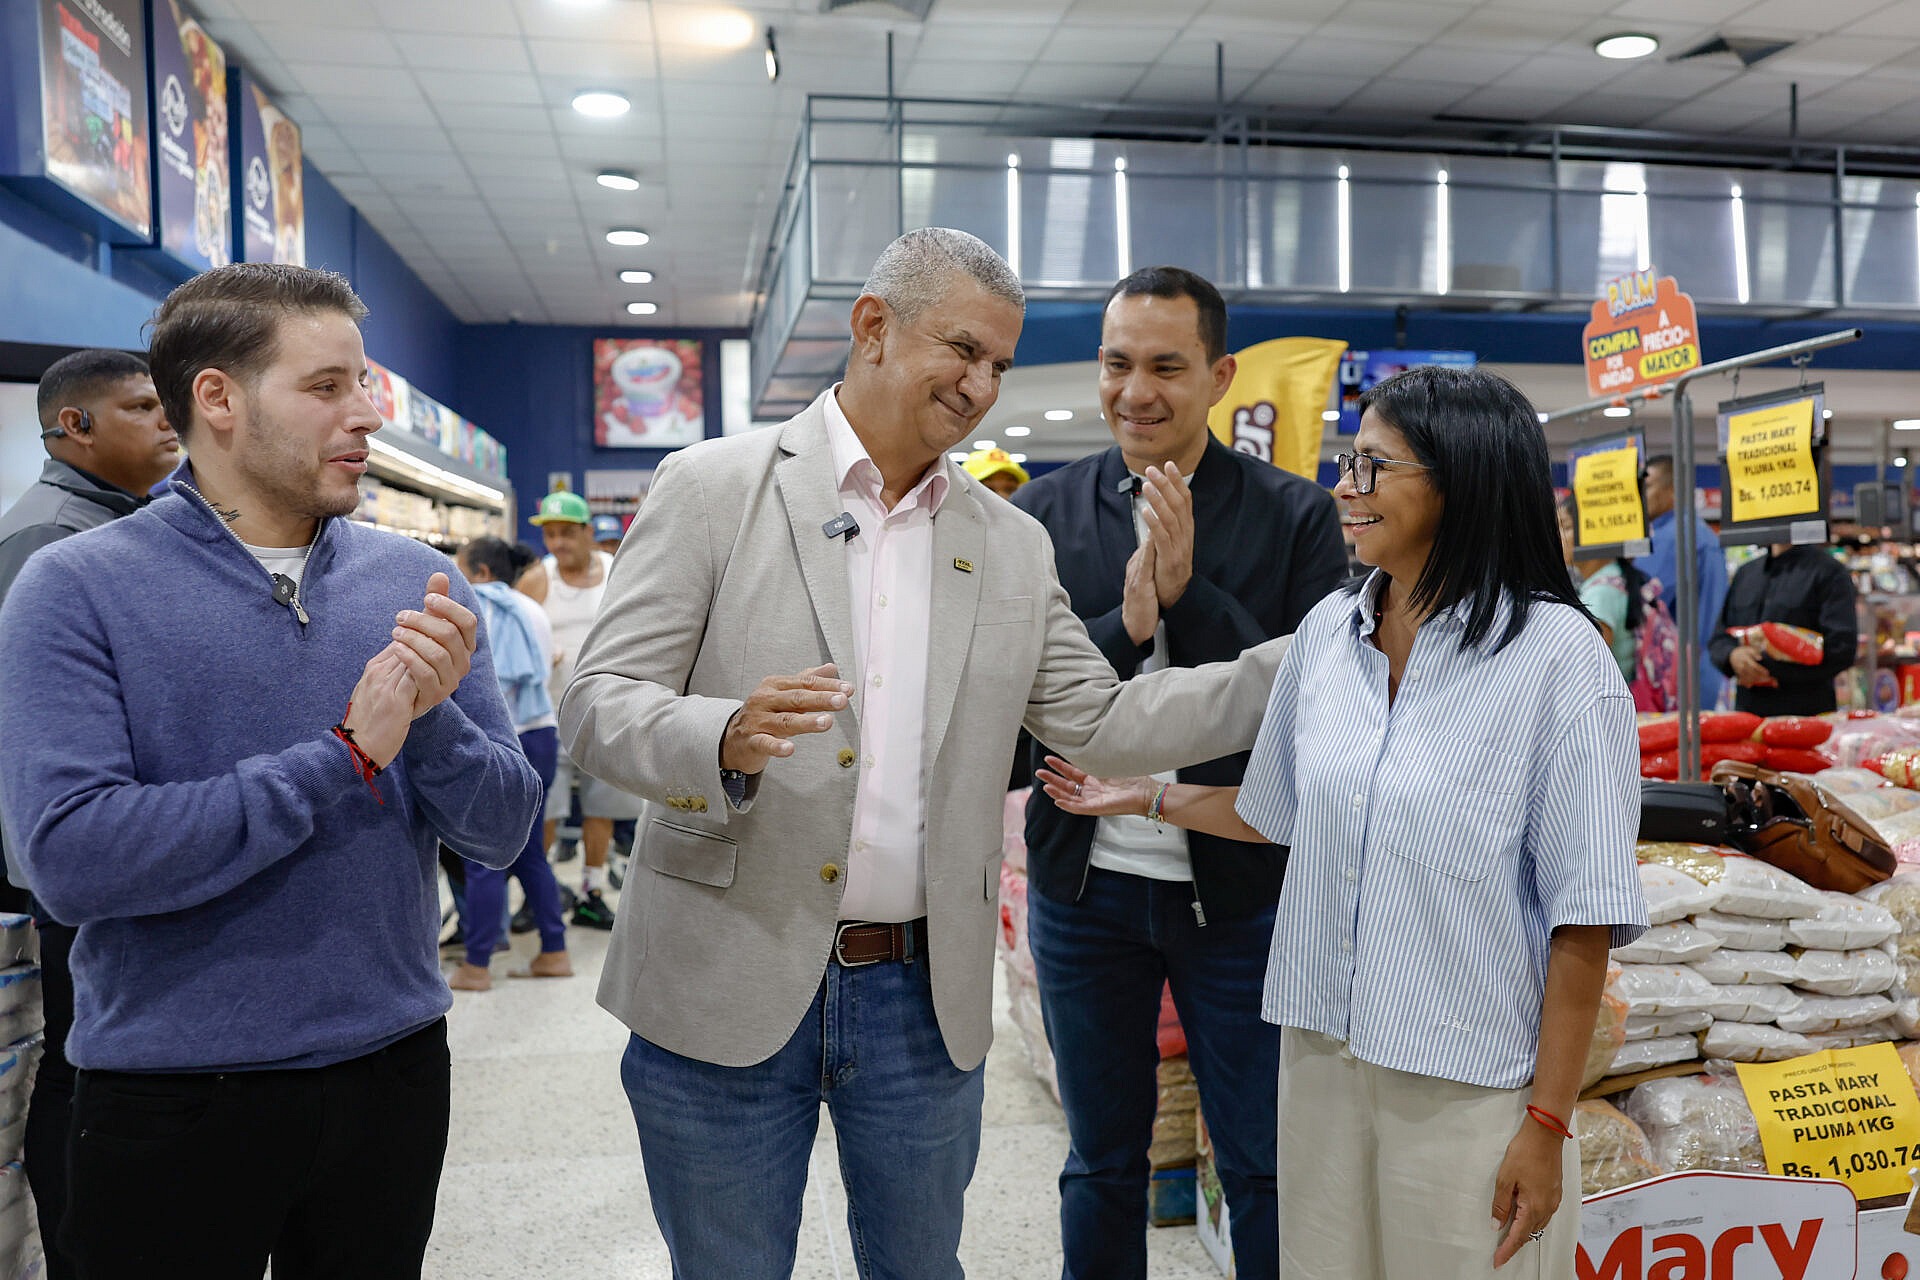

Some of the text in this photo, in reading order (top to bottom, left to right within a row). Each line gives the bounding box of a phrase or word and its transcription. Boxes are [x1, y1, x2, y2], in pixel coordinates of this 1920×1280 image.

[1658, 309, 1671, 328] A
[1589, 329, 1639, 360] COMPRA
[1642, 325, 1683, 353] PRECIO
[1646, 347, 1692, 373] MAYOR
[1740, 426, 1797, 445] PASTA MARY
[1738, 443, 1798, 461] TRADICIONAL
[1744, 458, 1796, 476] PLUMA 1KG
[1739, 480, 1811, 502] Bs. 1,030.74
[1769, 1082, 1832, 1103] PASTA
[1774, 1094, 1896, 1122] TRADICIONAL
[1793, 1116, 1895, 1143] PLUMA 1KG
[1782, 1144, 1920, 1179] Bs. 1,030.74
[1575, 1218, 1824, 1280] Mary
